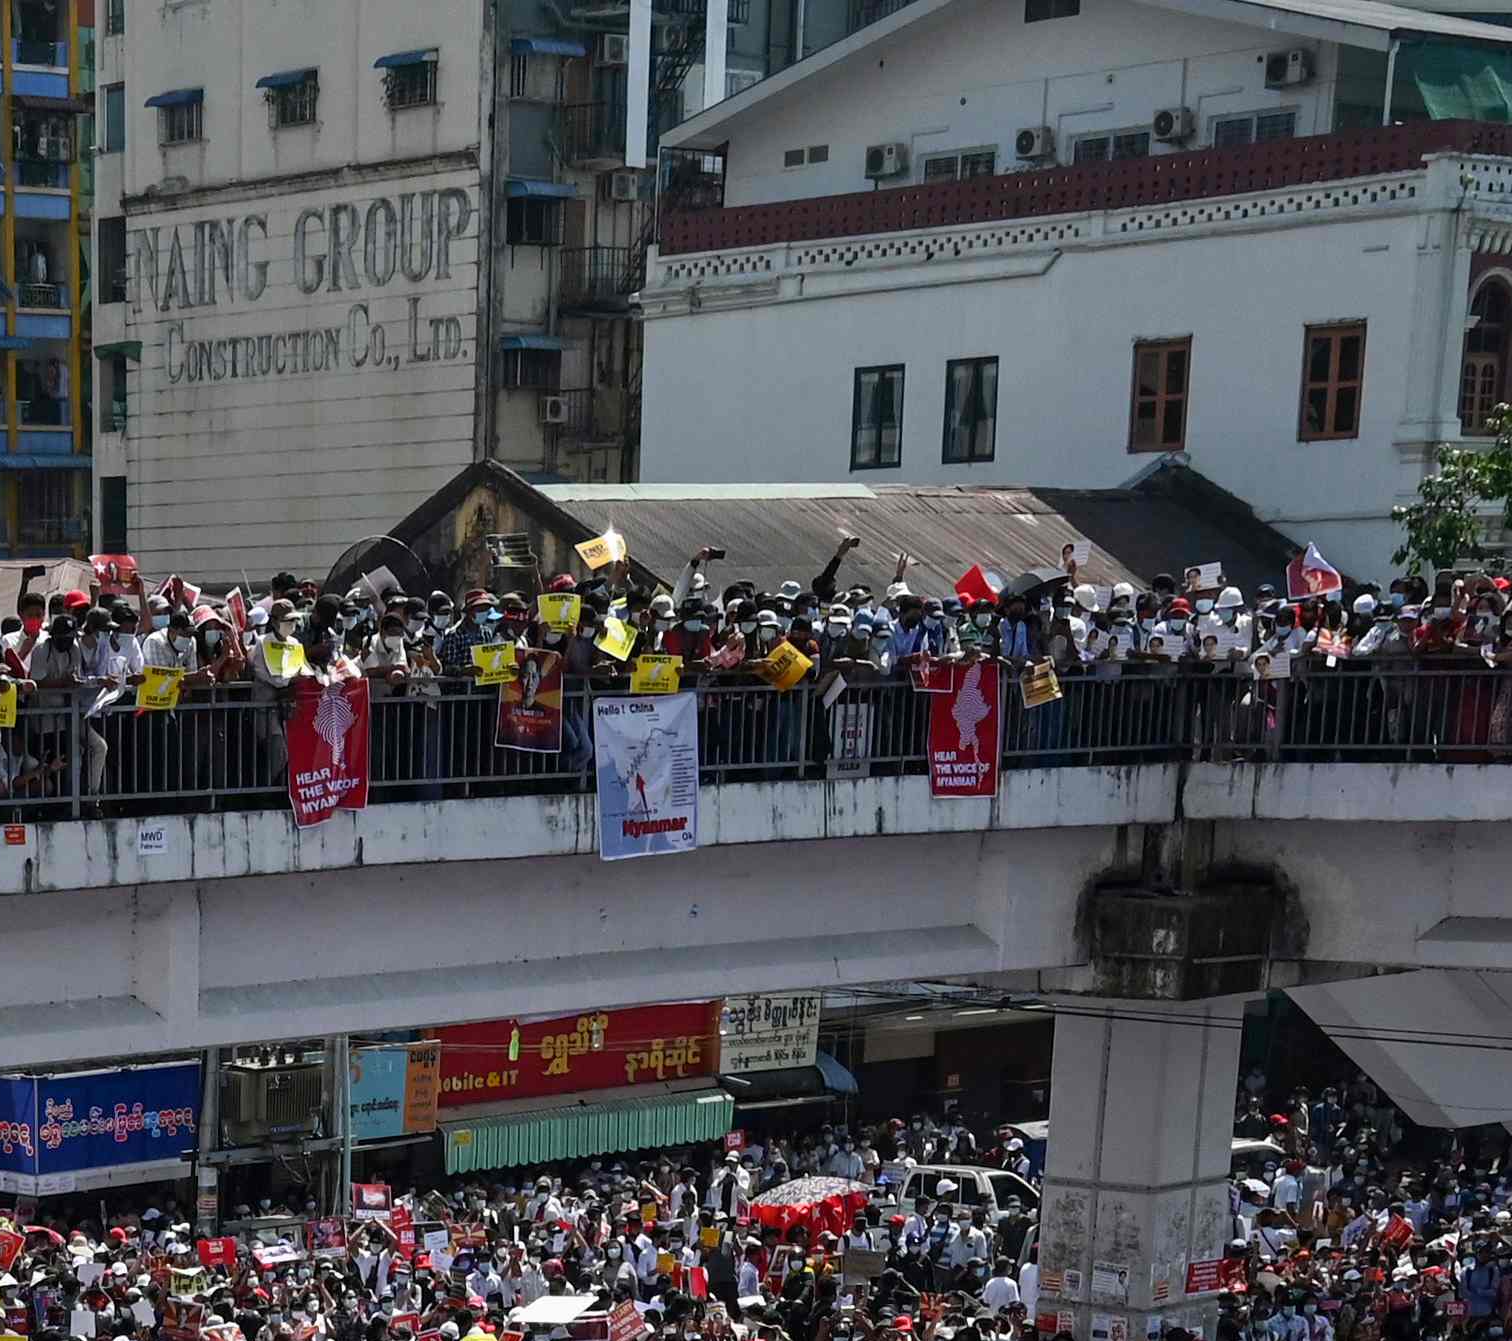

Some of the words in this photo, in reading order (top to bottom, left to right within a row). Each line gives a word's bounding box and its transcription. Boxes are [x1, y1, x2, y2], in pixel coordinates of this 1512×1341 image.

[130, 214, 270, 312] NAING
[291, 188, 473, 295] GROUP
[596, 704, 622, 718] Hello
[629, 702, 655, 714] China
[933, 751, 957, 762] HEAR
[295, 766, 332, 785] HEAR
[935, 763, 955, 774] THE
[955, 763, 978, 774] VOICE
[979, 762, 991, 774] OF
[936, 775, 977, 787] MYANMAR
[298, 781, 325, 798] THE
[622, 816, 689, 839] Myanmar
